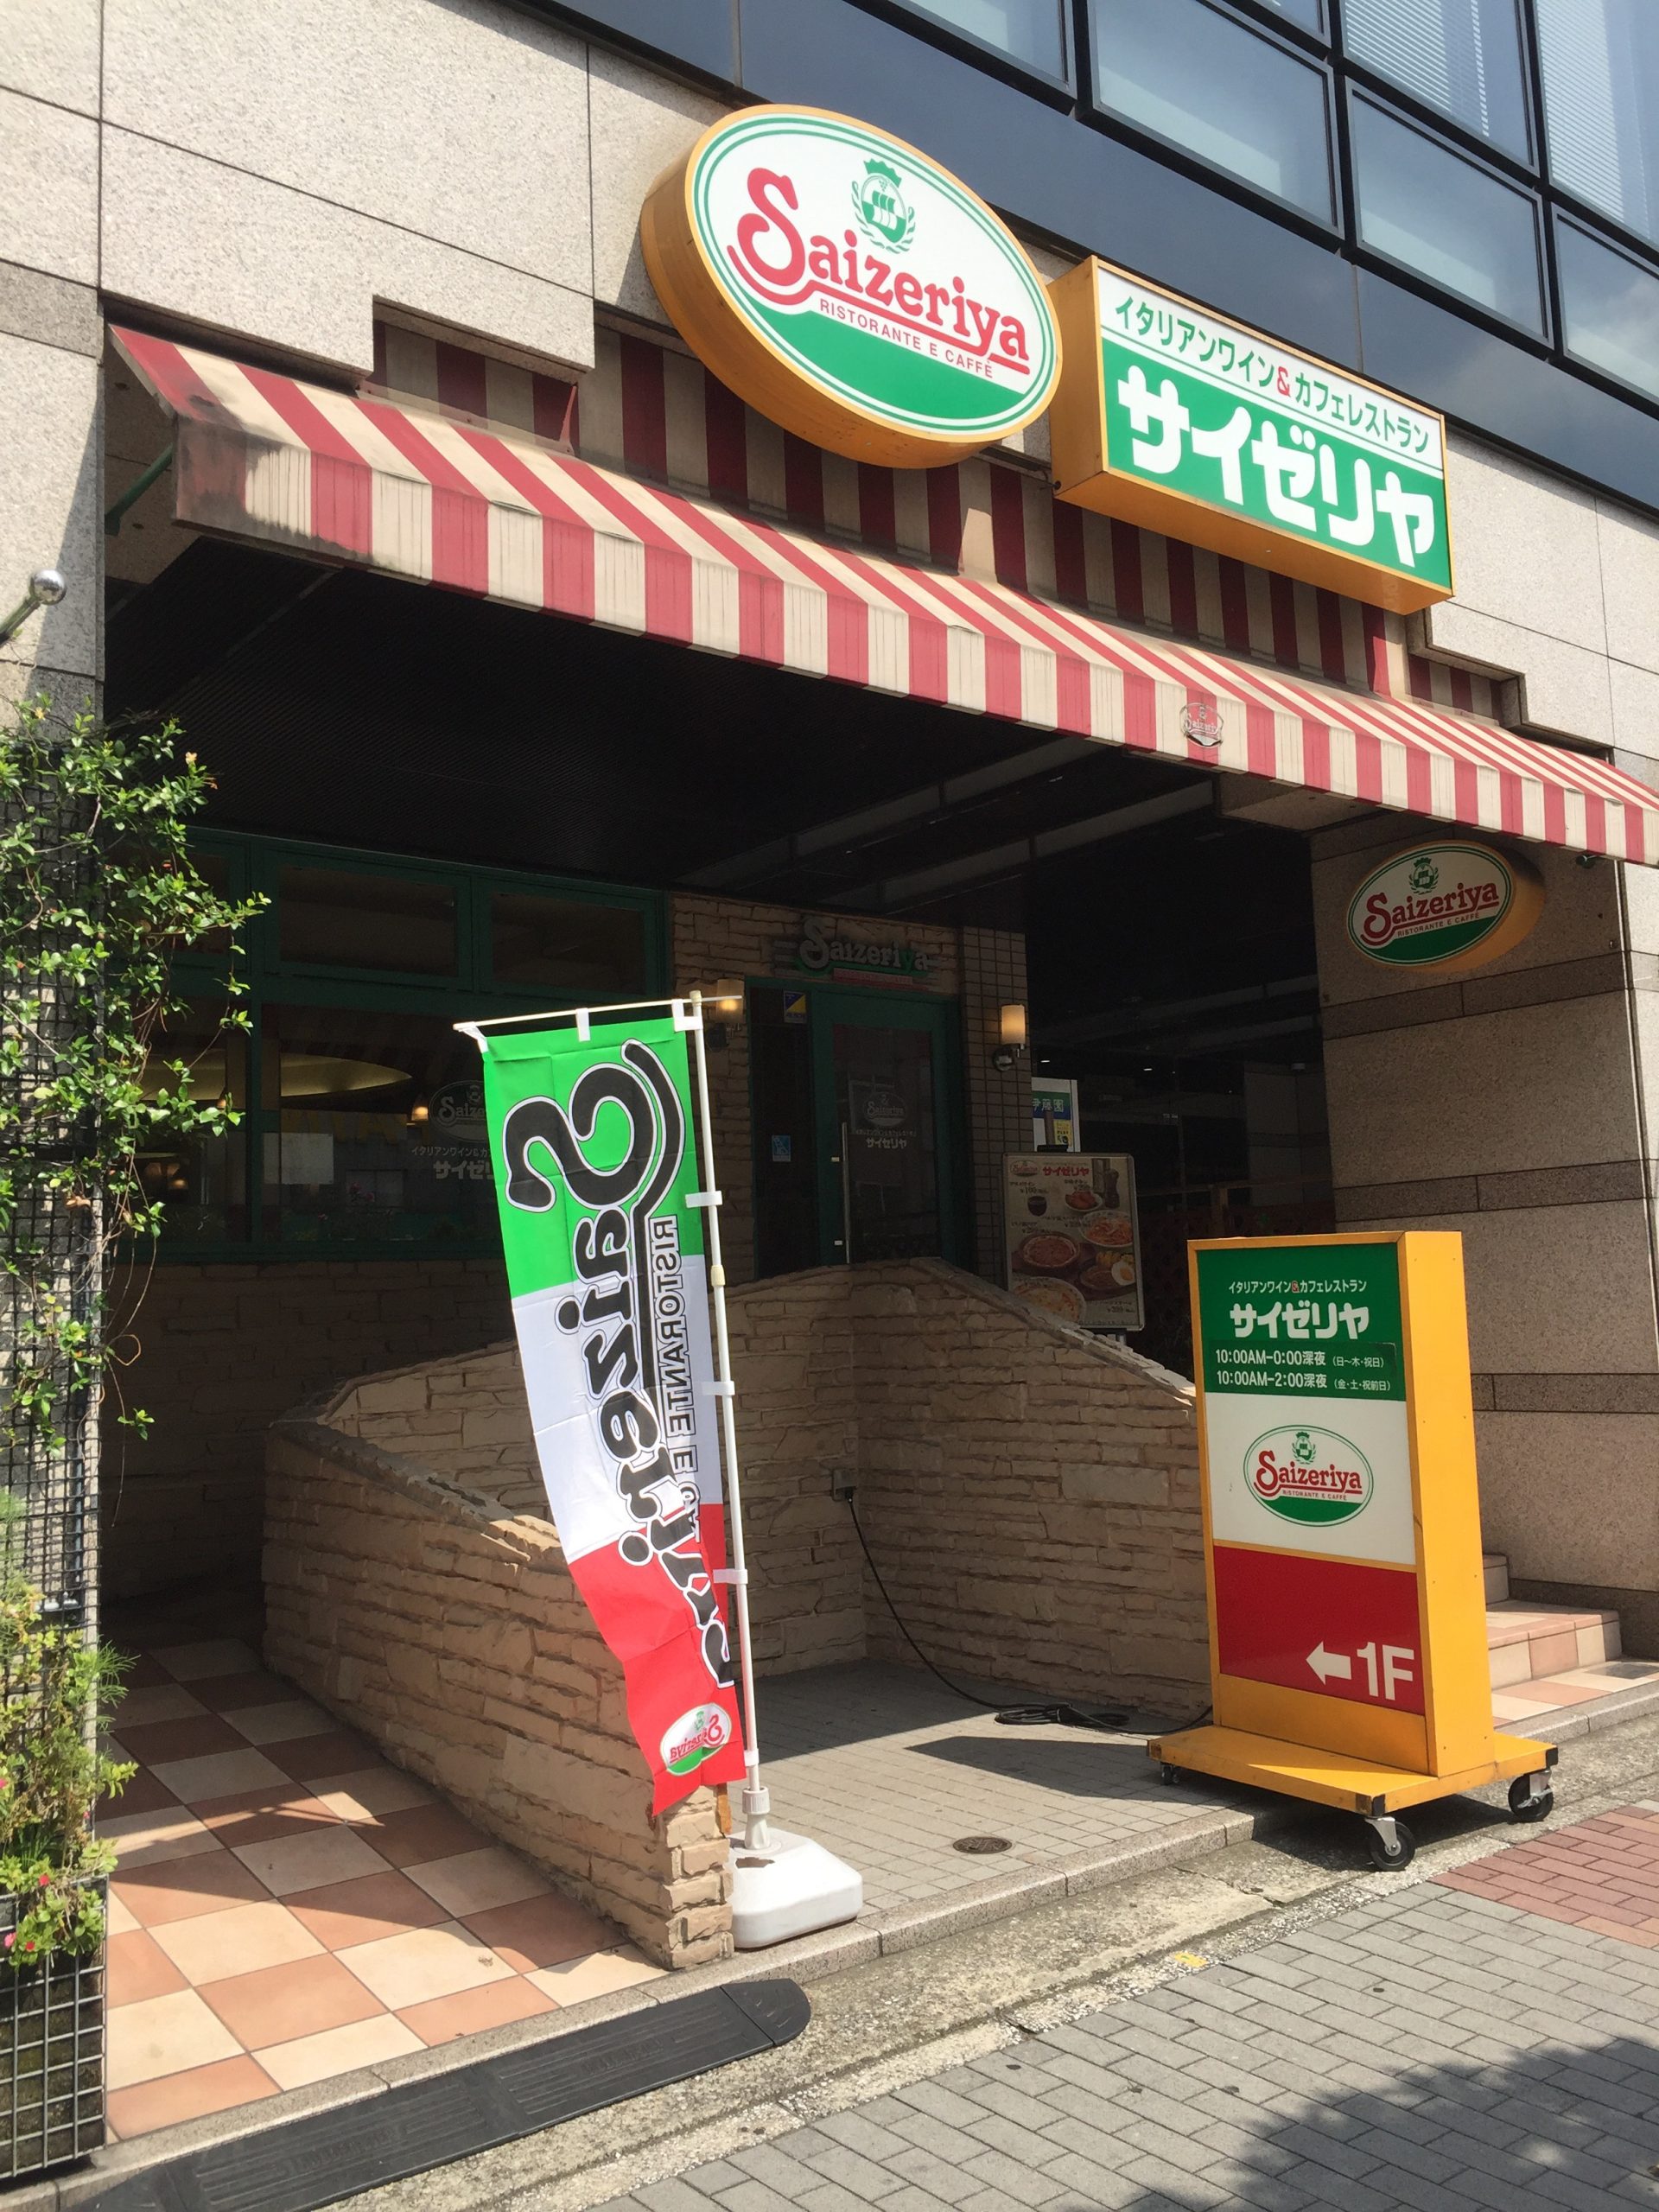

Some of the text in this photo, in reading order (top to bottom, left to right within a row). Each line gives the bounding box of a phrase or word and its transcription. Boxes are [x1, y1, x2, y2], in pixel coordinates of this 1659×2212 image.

[734, 167, 1030, 366] Saizeriya
[819, 297, 994, 378] RISTORANTE E CAFFÈ
[1115, 296, 1430, 454] イタリアンワイン&カフェレストラン
[1116, 365, 1435, 568] サイゼリヤ
[1362, 882, 1500, 939] Saizeriya
[1397, 920, 1444, 938] RISTORANTE
[1228, 1280, 1368, 1294] イタリアンワイン&カフェレストラン
[1229, 1300, 1370, 1340] サイゼリヤ
[1255, 1450, 1363, 1492] Saizeriya
[1356, 1641, 1414, 1700] 1F
